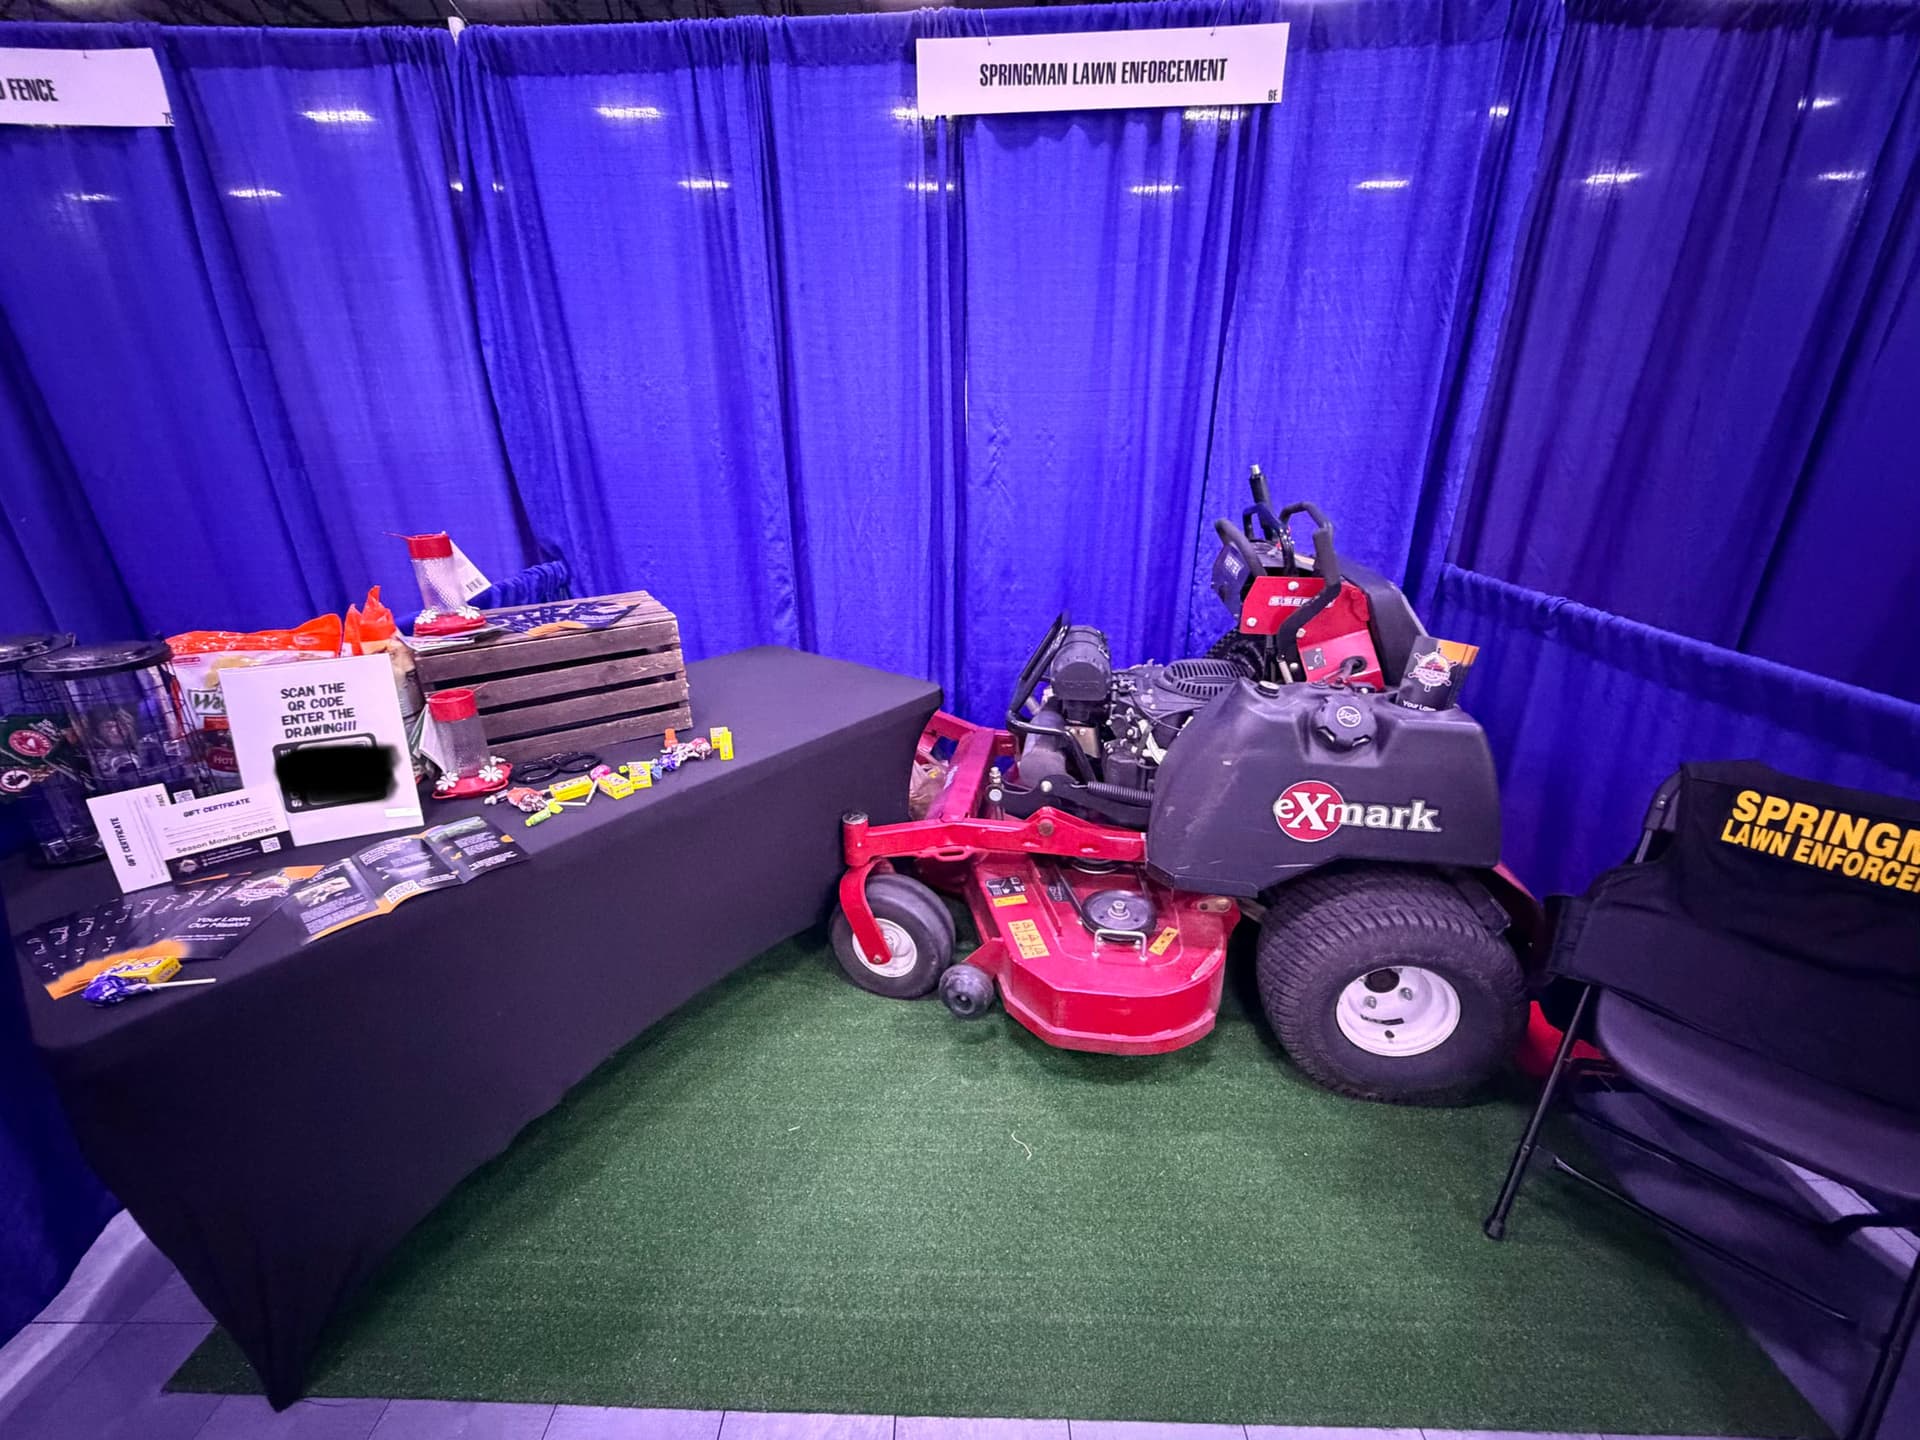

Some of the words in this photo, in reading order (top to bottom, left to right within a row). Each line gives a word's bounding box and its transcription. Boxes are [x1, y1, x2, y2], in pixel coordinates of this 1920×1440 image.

[979, 62, 1068, 86] SPRINGMAN
[1072, 62, 1117, 85] LAWN
[1121, 58, 1228, 84] ENFORCEMENT
[6, 78, 59, 102] FENCE
[280, 685, 316, 699] SCAN
[318, 682, 346, 695] THE
[287, 700, 306, 711] QR
[310, 696, 345, 709] CODE
[281, 711, 325, 726] ENTER
[328, 707, 355, 721] THE
[176, 842, 208, 854] Season
[242, 825, 277, 838] Contract
[1721, 819, 1792, 858] LAWN
[1792, 838, 1920, 894] ENFORCE
